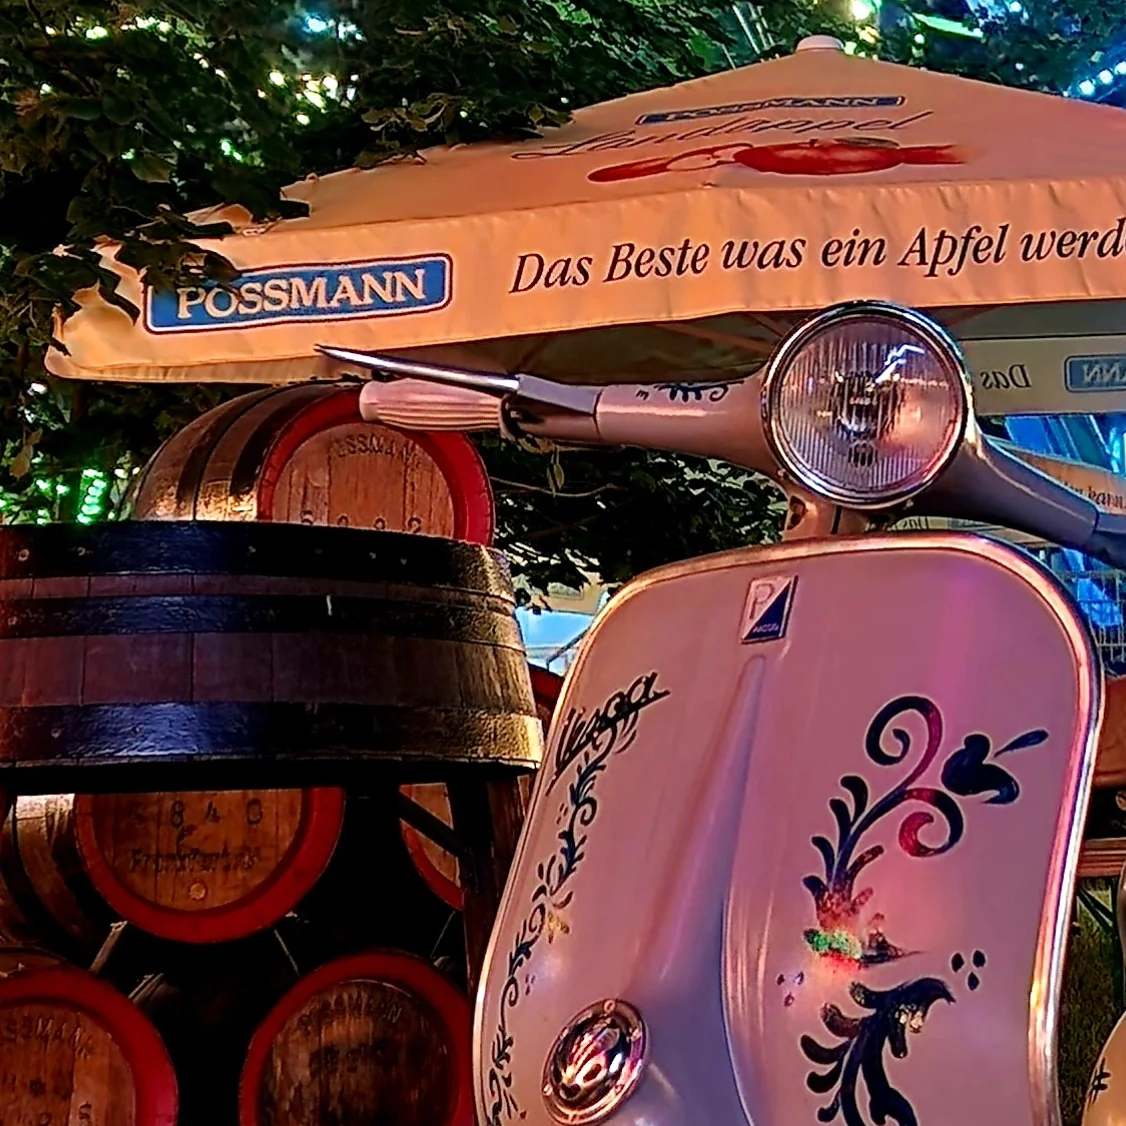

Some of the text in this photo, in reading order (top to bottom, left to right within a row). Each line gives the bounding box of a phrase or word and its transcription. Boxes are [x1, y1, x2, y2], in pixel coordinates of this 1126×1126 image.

[508, 253, 593, 295] Das
[602, 238, 710, 284] Beste
[720, 234, 807, 270] was
[821, 227, 886, 268] ein
[897, 224, 1011, 278] Apfel
[177, 268, 426, 320] POSSMANN
